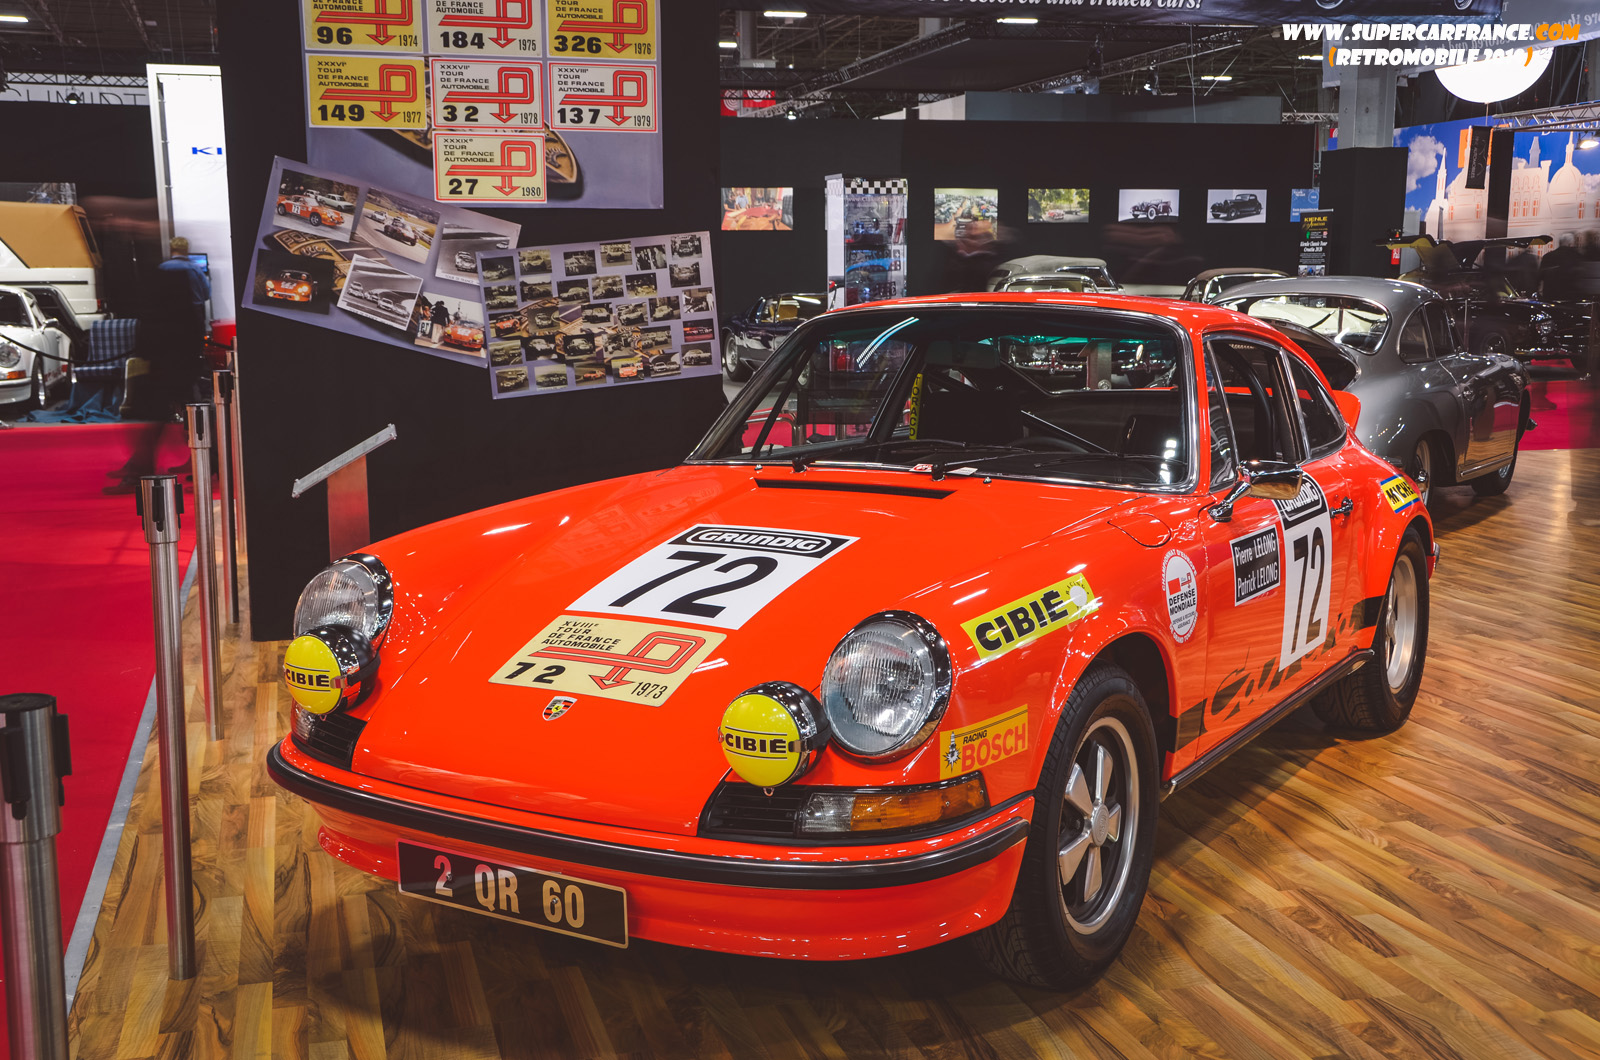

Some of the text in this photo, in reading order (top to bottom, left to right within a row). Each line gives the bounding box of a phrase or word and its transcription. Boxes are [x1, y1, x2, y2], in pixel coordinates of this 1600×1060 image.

[317, 26, 418, 47] 96 1974
[440, 31, 536, 51] 184 1975
[554, 35, 652, 55] 326 1976
[318, 104, 421, 123] 149 1977
[443, 105, 538, 124] 32 1978
[557, 107, 651, 127] 137 1979
[448, 178, 541, 197] 27 1980
[698, 530, 821, 550] GRUNDIG
[1234, 532, 1276, 567] Pierre LELONG
[608, 550, 778, 618] 72
[1237, 561, 1278, 598] Patrick LELONG
[1169, 588, 1196, 606] DEFENSE
[1290, 526, 1325, 655] 72
[1169, 598, 1196, 616] MONDIALE
[541, 638, 615, 651] AUTOMOBILE
[567, 634, 621, 645] FRANCE
[504, 662, 668, 700] 72 1973
[961, 722, 1026, 773] BOSCH
[963, 730, 988, 745] RACING
[434, 855, 585, 929] 2 QR 60
